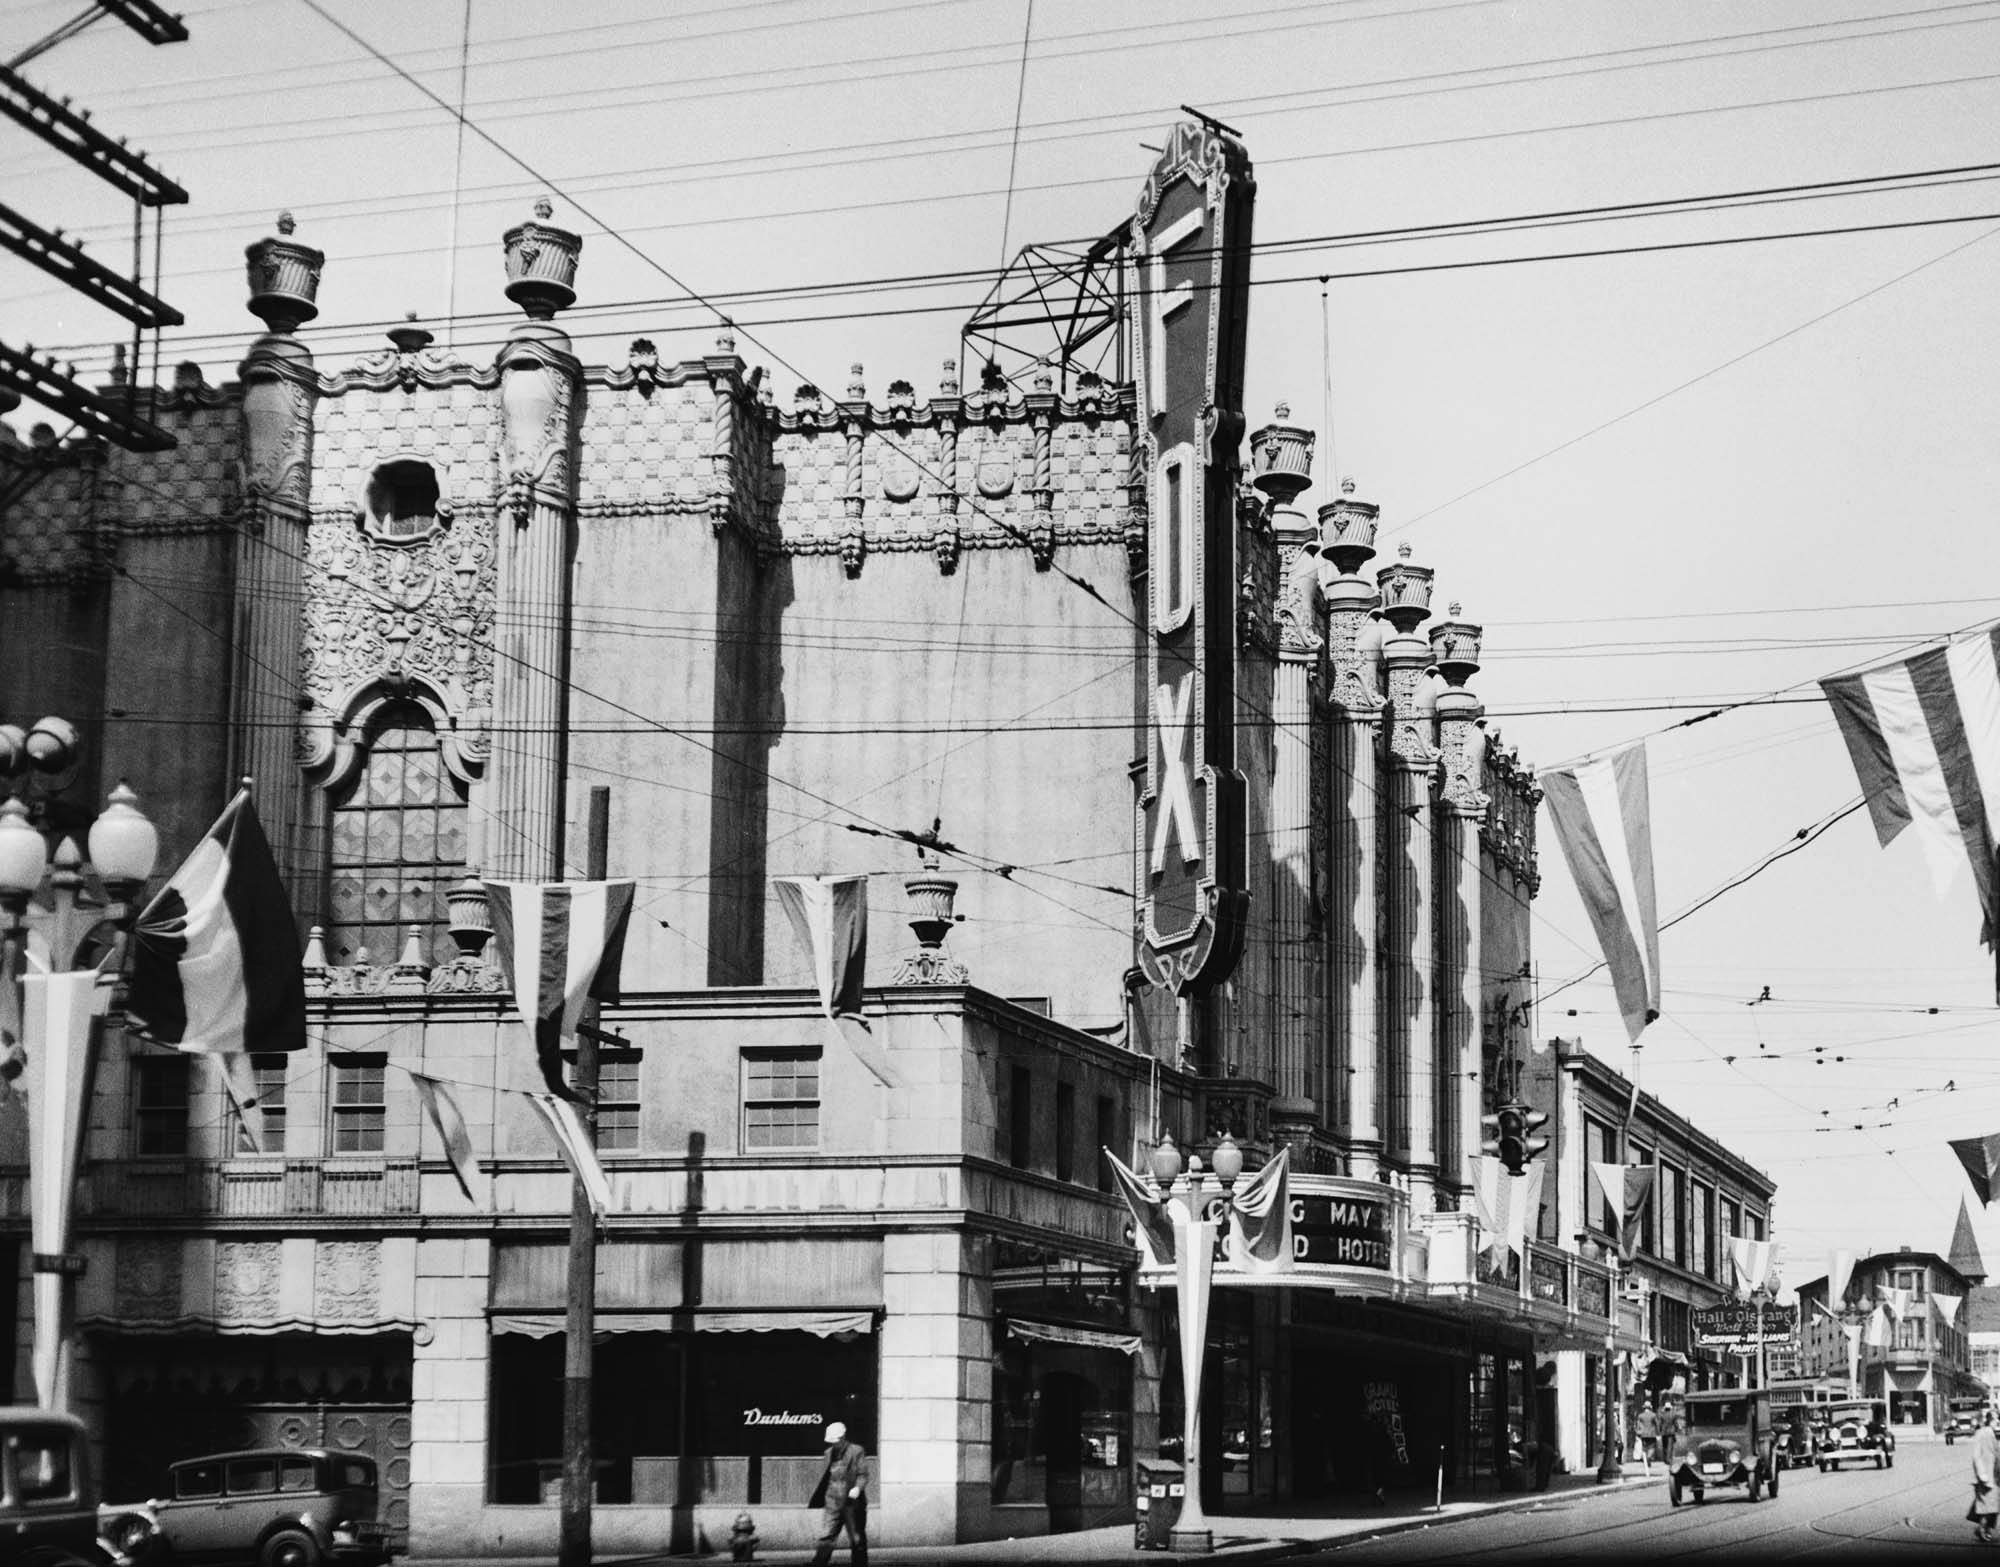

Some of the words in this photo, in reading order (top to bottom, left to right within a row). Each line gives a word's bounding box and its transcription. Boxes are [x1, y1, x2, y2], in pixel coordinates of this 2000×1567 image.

[1149, 206, 1205, 874] FOX
[1330, 1201, 1372, 1229] MAY
[1697, 1311, 1724, 1324] Hall
[1736, 1309, 1792, 1326] Olsang
[743, 1407, 824, 1426] Dunham's
